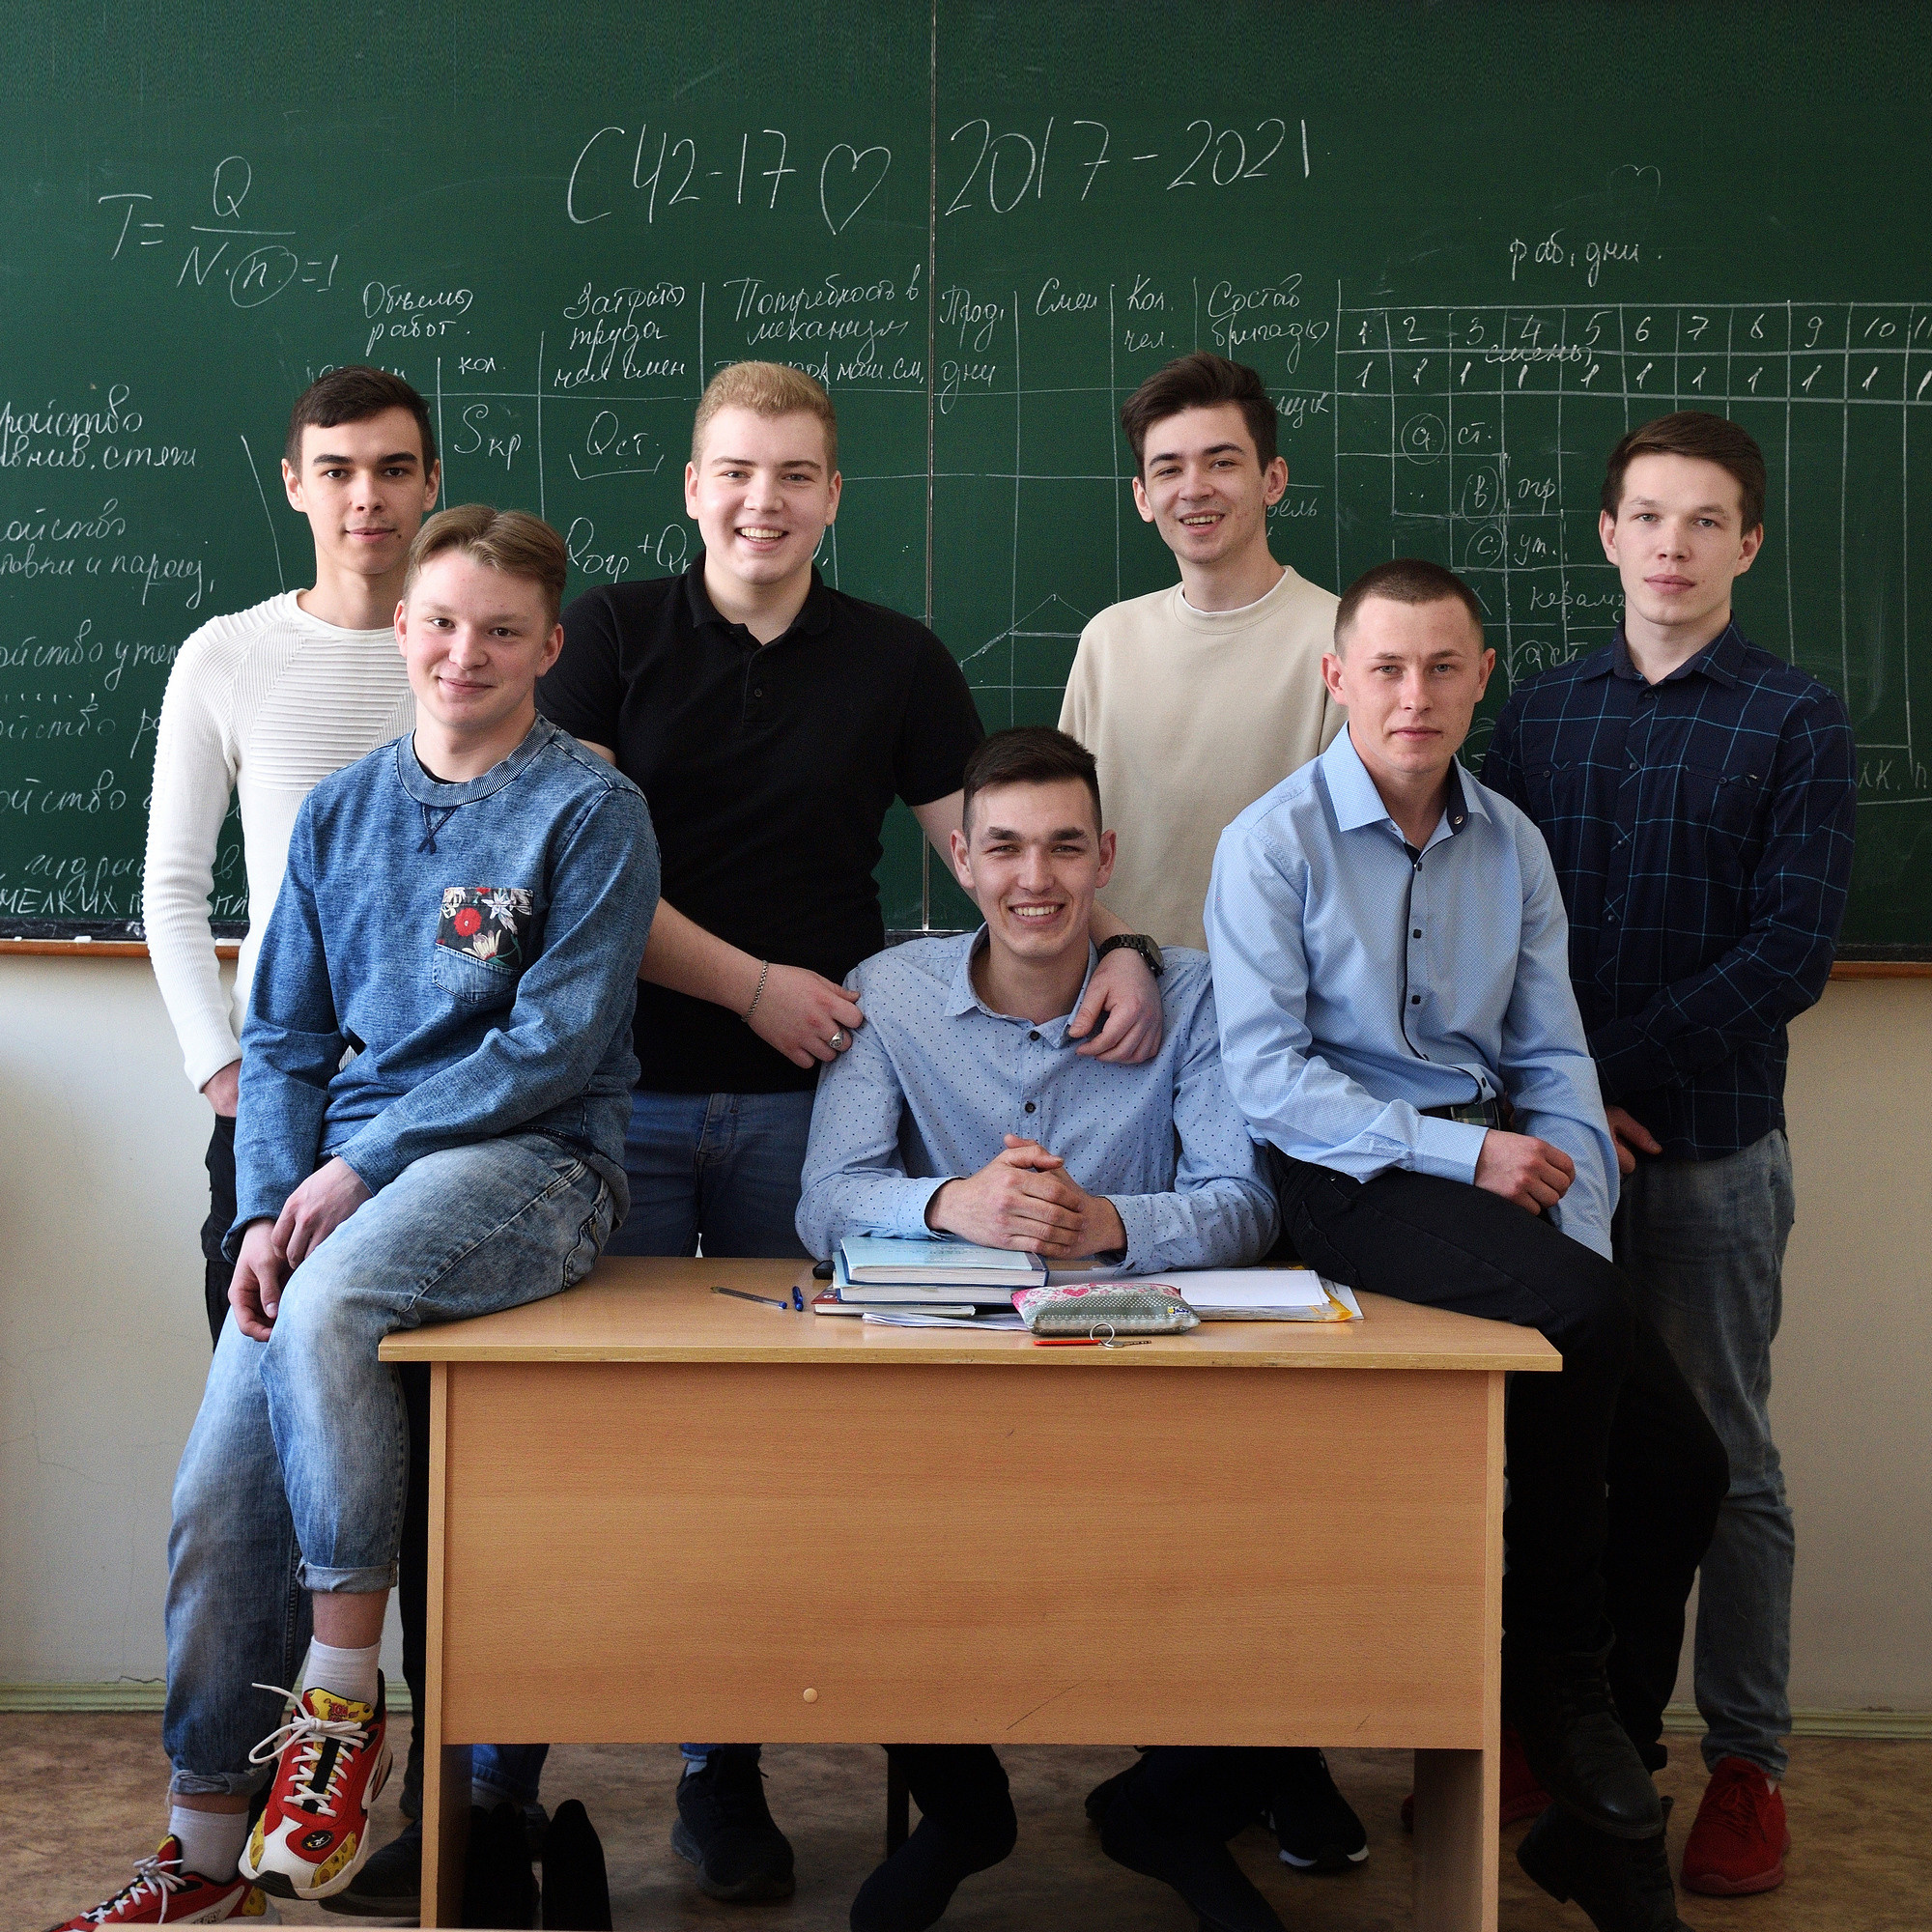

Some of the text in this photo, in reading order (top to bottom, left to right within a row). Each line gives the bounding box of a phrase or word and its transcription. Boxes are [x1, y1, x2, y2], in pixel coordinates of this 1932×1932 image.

[213, 156, 251, 218] Q
[1403, 316, 1428, 342] 2
[1466, 316, 1485, 346] 3
[1520, 314, 1543, 348] 4
[1584, 310, 1613, 346] 5
[1635, 316, 1652, 342] 6
[1687, 315, 1710, 341] 7
[1804, 315, 1824, 348] 9
[1863, 317, 1896, 338] 10
[1355, 360, 1374, 388] 1
[1412, 357, 1428, 385] 1
[1459, 361, 1471, 386] 1
[1518, 363, 1529, 389] 1
[1580, 363, 1600, 388] 1
[1636, 362, 1653, 389] 1
[1691, 366, 1707, 391] 1
[1747, 367, 1764, 393] 1
[1801, 364, 1823, 393] 1
[1861, 366, 1879, 392] 1
